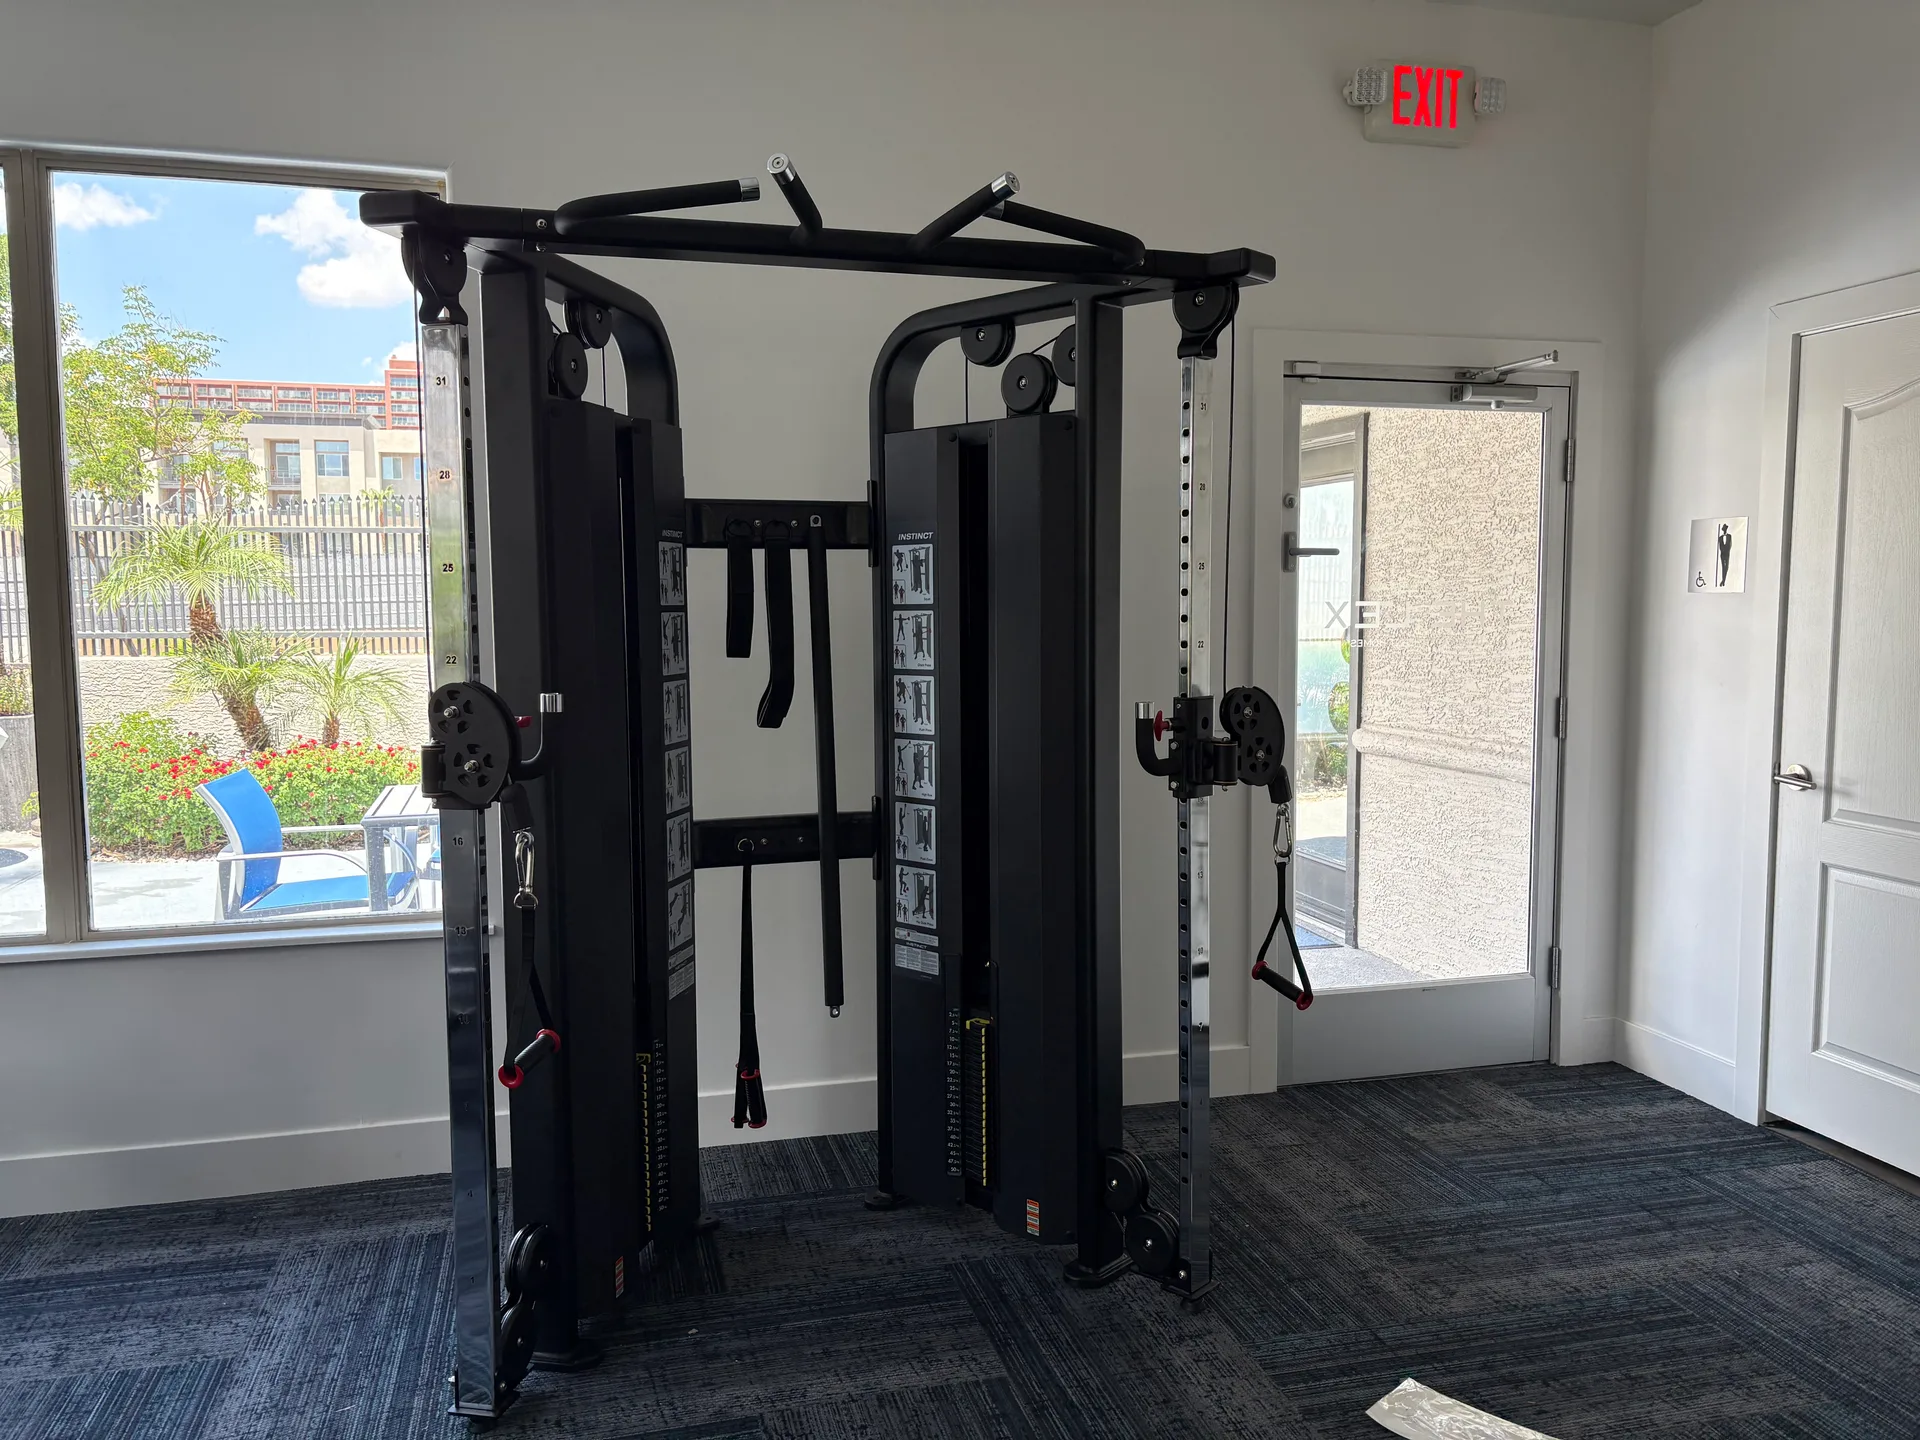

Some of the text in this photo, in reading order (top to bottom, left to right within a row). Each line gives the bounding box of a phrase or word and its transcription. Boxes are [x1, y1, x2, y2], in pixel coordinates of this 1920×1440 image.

[1392, 64, 1465, 129] EXIT
[435, 376, 446, 386] 31
[1200, 402, 1207, 411] 31
[439, 470, 451, 480] 28
[661, 529, 684, 539] INSTINCT
[898, 531, 934, 541] INSTINCT
[442, 563, 454, 572] 25
[1198, 562, 1205, 570] 25
[1197, 640, 1205, 648] 22
[445, 655, 457, 664] 22
[452, 837, 464, 846] 16
[455, 926, 467, 935] 13
